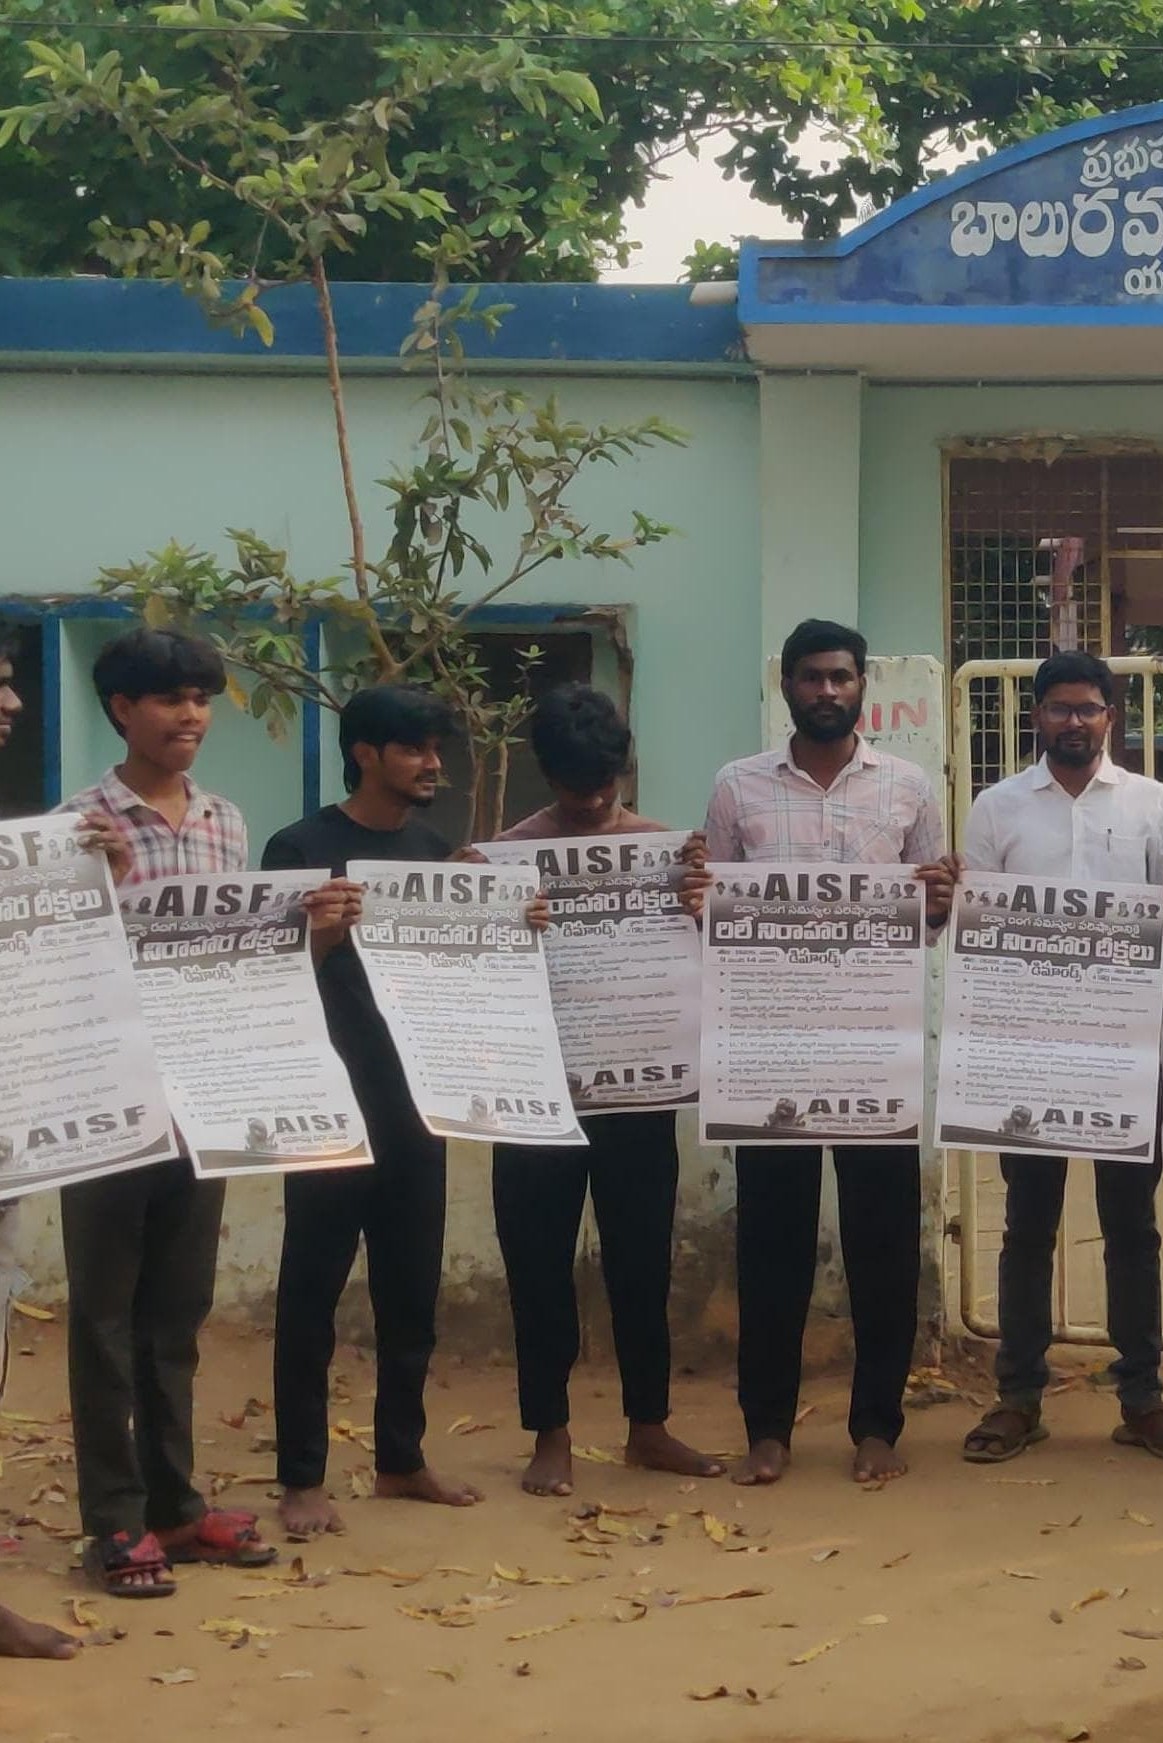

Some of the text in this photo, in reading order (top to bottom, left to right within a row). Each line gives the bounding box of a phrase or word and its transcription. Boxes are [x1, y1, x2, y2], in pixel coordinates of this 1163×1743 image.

[950, 187, 1119, 258] బాలుర
[535, 844, 638, 876] AISF
[155, 883, 272, 917] AISF
[402, 873, 496, 904] AISF
[764, 873, 869, 902] AISF
[1010, 885, 1115, 918] AISF
[593, 1064, 690, 1086] AISF
[495, 1097, 562, 1117] AISF
[808, 1098, 904, 1114] AISF
[1042, 1108, 1139, 1128] AISF
[27, 1104, 146, 1149] AISF
[275, 1113, 349, 1132] AISF
